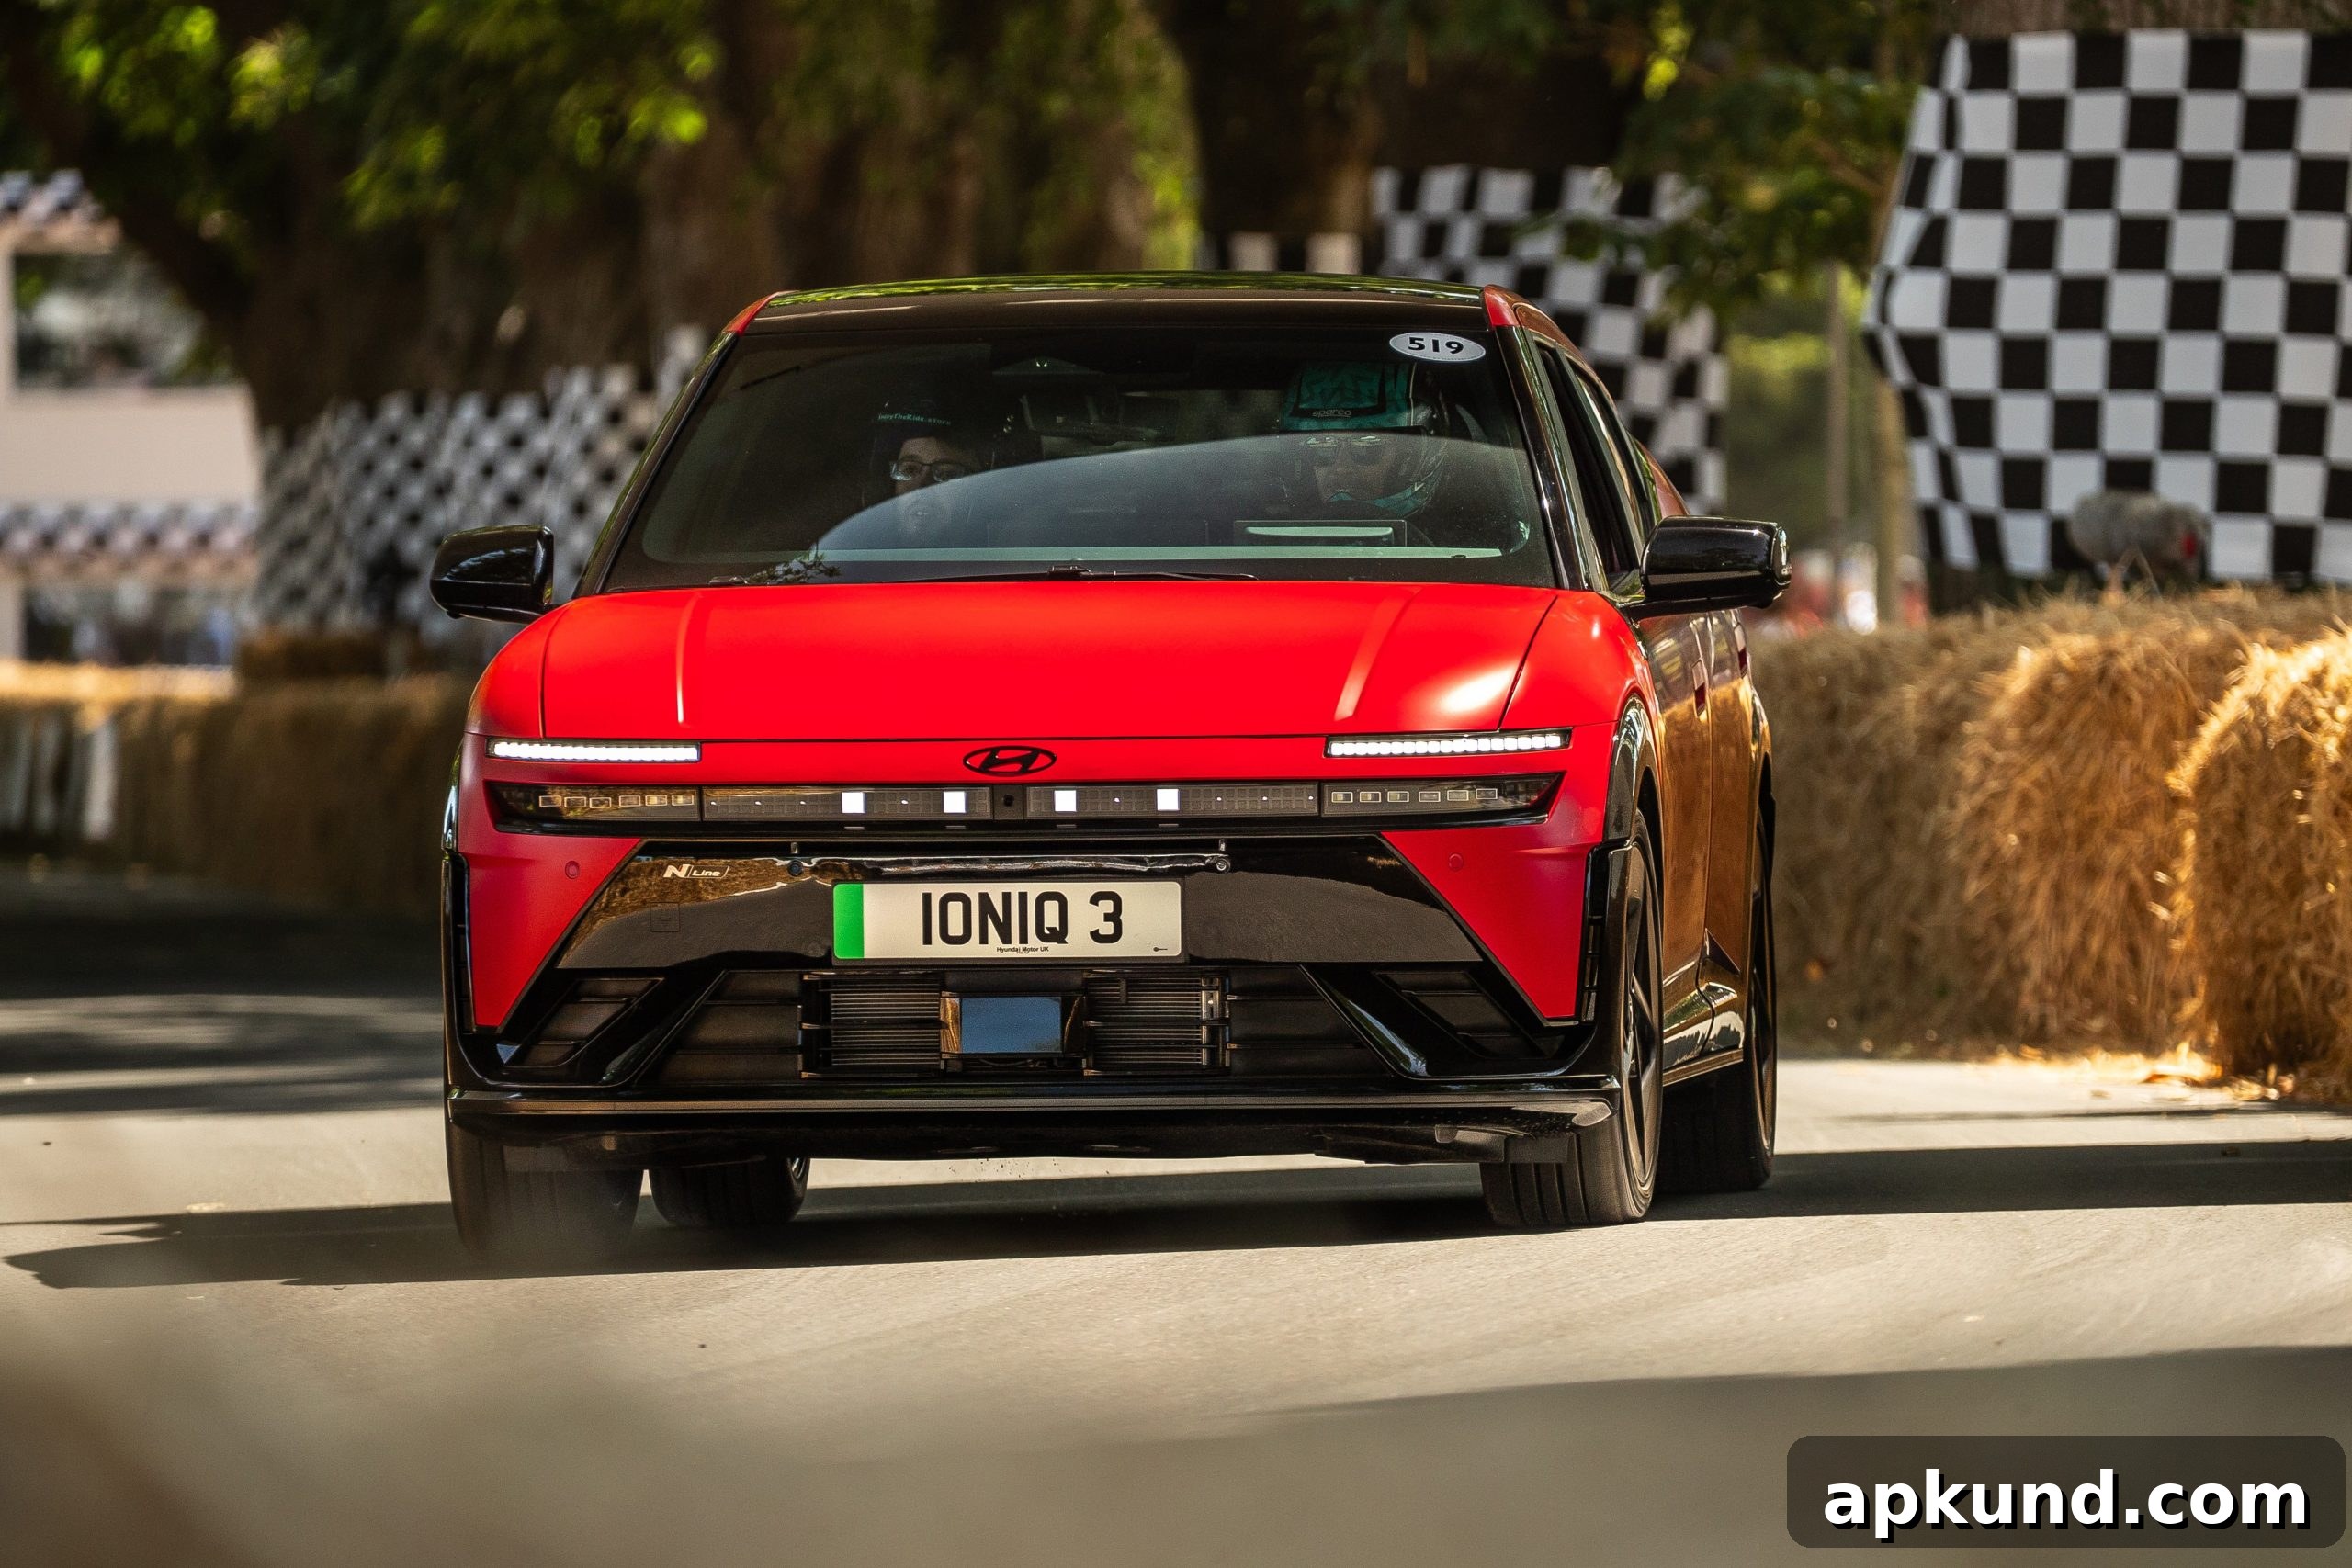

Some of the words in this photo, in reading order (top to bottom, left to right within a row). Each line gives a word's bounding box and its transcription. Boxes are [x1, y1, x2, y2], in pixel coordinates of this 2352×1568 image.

[1408, 337, 1464, 354] 519
[663, 863, 689, 877] N
[692, 869, 721, 877] Line
[922, 891, 1068, 945] IONIQ
[1089, 891, 1123, 944] 3
